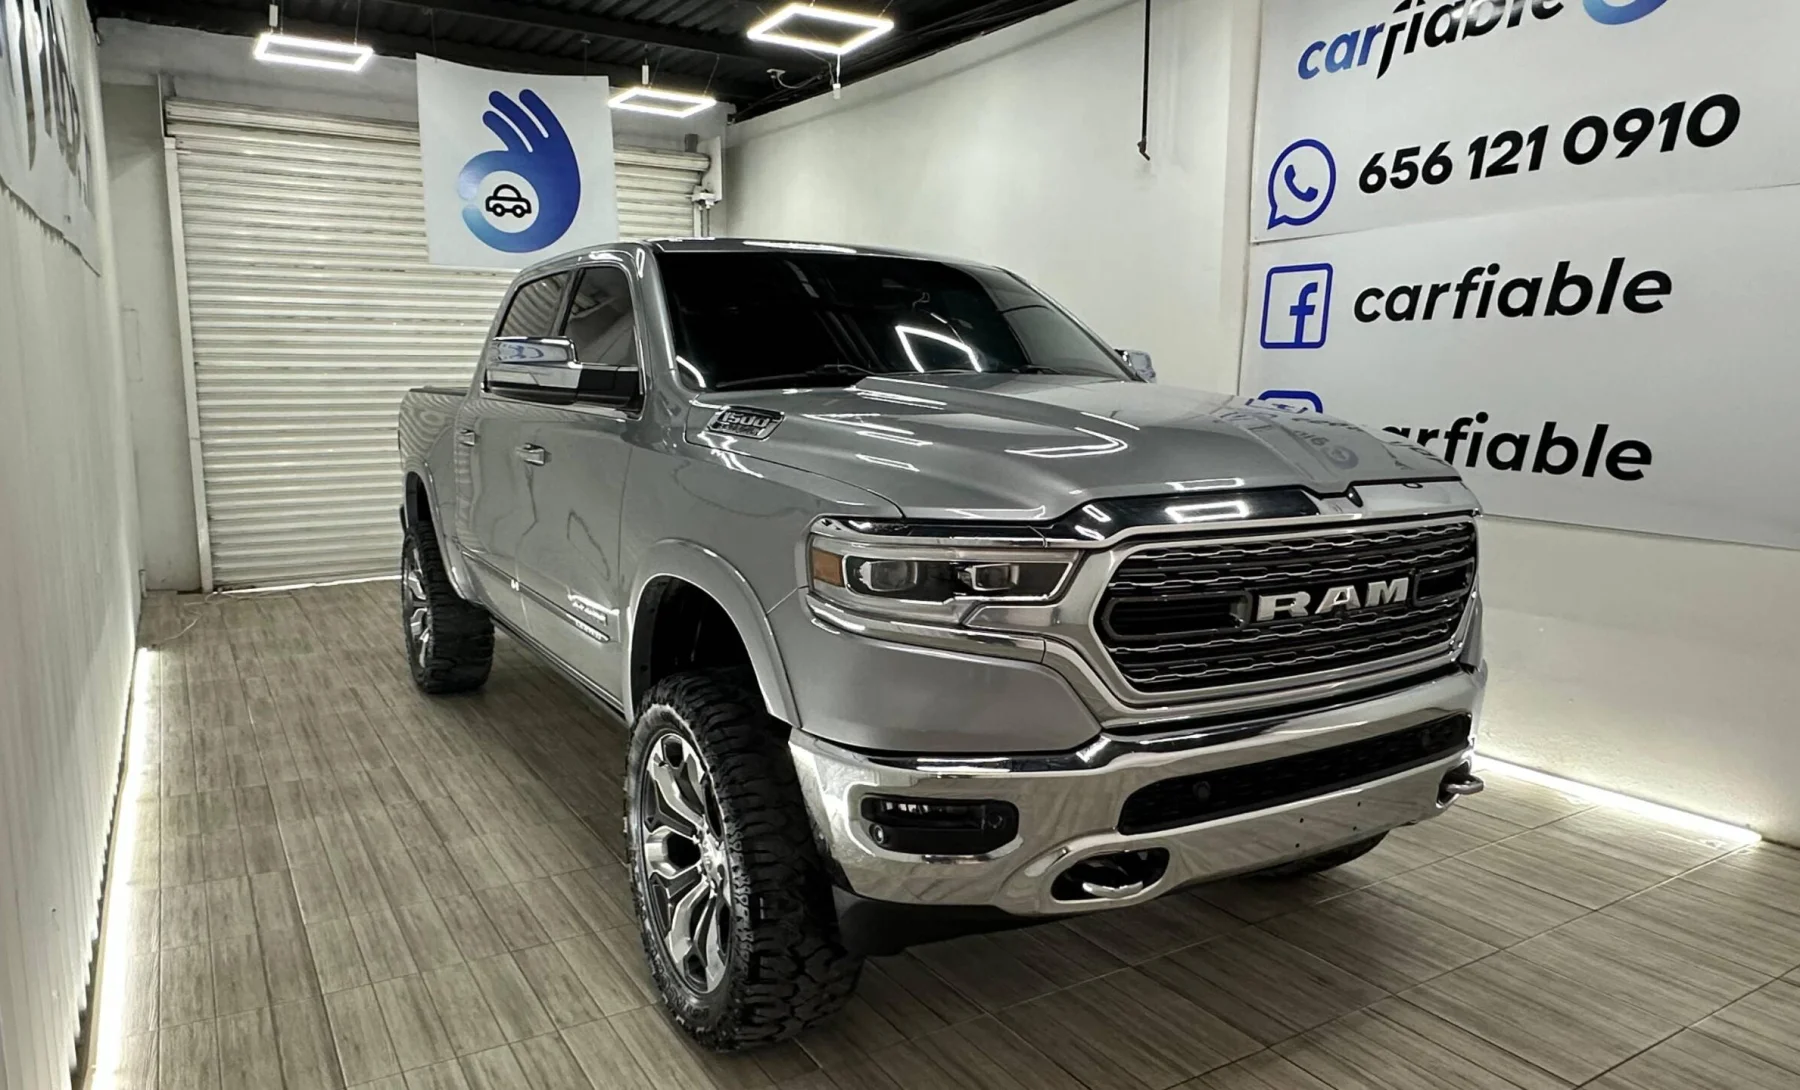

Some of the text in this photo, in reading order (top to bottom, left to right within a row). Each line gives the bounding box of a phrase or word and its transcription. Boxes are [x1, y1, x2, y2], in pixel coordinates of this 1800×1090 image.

[1358, 93, 1741, 194] 656 121 0910
[1353, 256, 1673, 323] carfiable
[1382, 411, 1653, 482] rfiable
[1256, 577, 1409, 622] RAM
